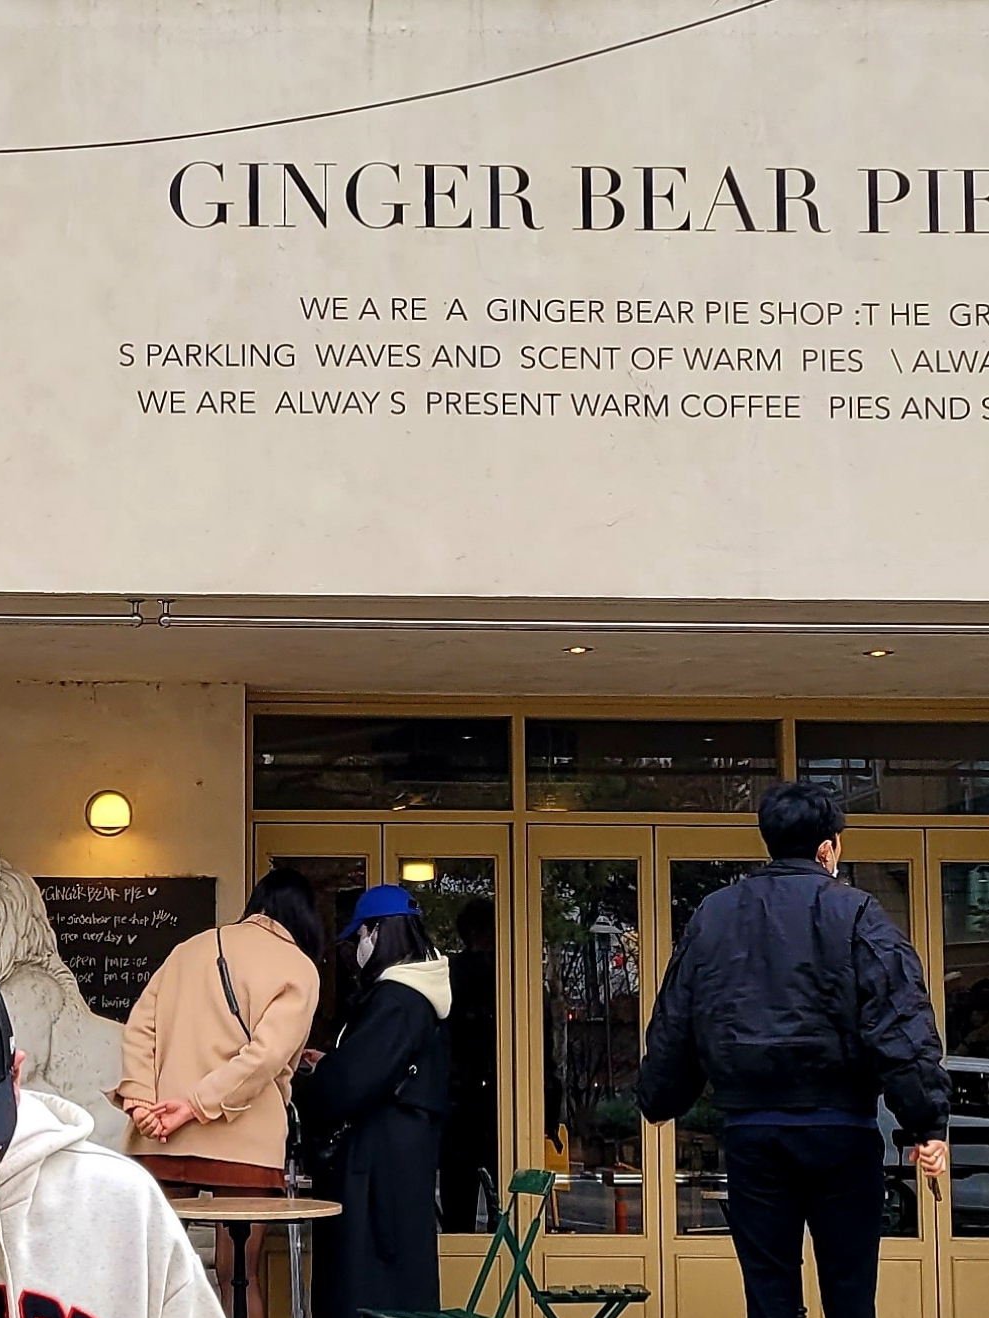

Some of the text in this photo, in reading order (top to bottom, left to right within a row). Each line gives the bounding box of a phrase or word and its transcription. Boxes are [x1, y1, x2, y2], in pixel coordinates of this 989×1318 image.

[169, 161, 545, 231] GINGER
[571, 166, 831, 234] BEAR
[299, 296, 349, 320] WE
[445, 298, 468, 321] A
[486, 298, 605, 324] GINGER
[616, 300, 694, 324] BEAR
[706, 301, 749, 325] PIE
[759, 301, 843, 326] SHOP
[315, 343, 421, 368] WAVES
[431, 344, 501, 369] AND
[520, 345, 622, 370] SCENT
[631, 347, 674, 371] OF
[683, 347, 781, 372] WARM
[802, 349, 863, 373] PIES
[137, 390, 186, 414] WE
[196, 391, 256, 414] ARE
[426, 391, 562, 416] PRESENT
[570, 393, 669, 418] WARM
[680, 394, 801, 419] COFFEE
[830, 396, 890, 420] PIES
[900, 397, 971, 420] AND
[75, 972, 94, 984] lose
